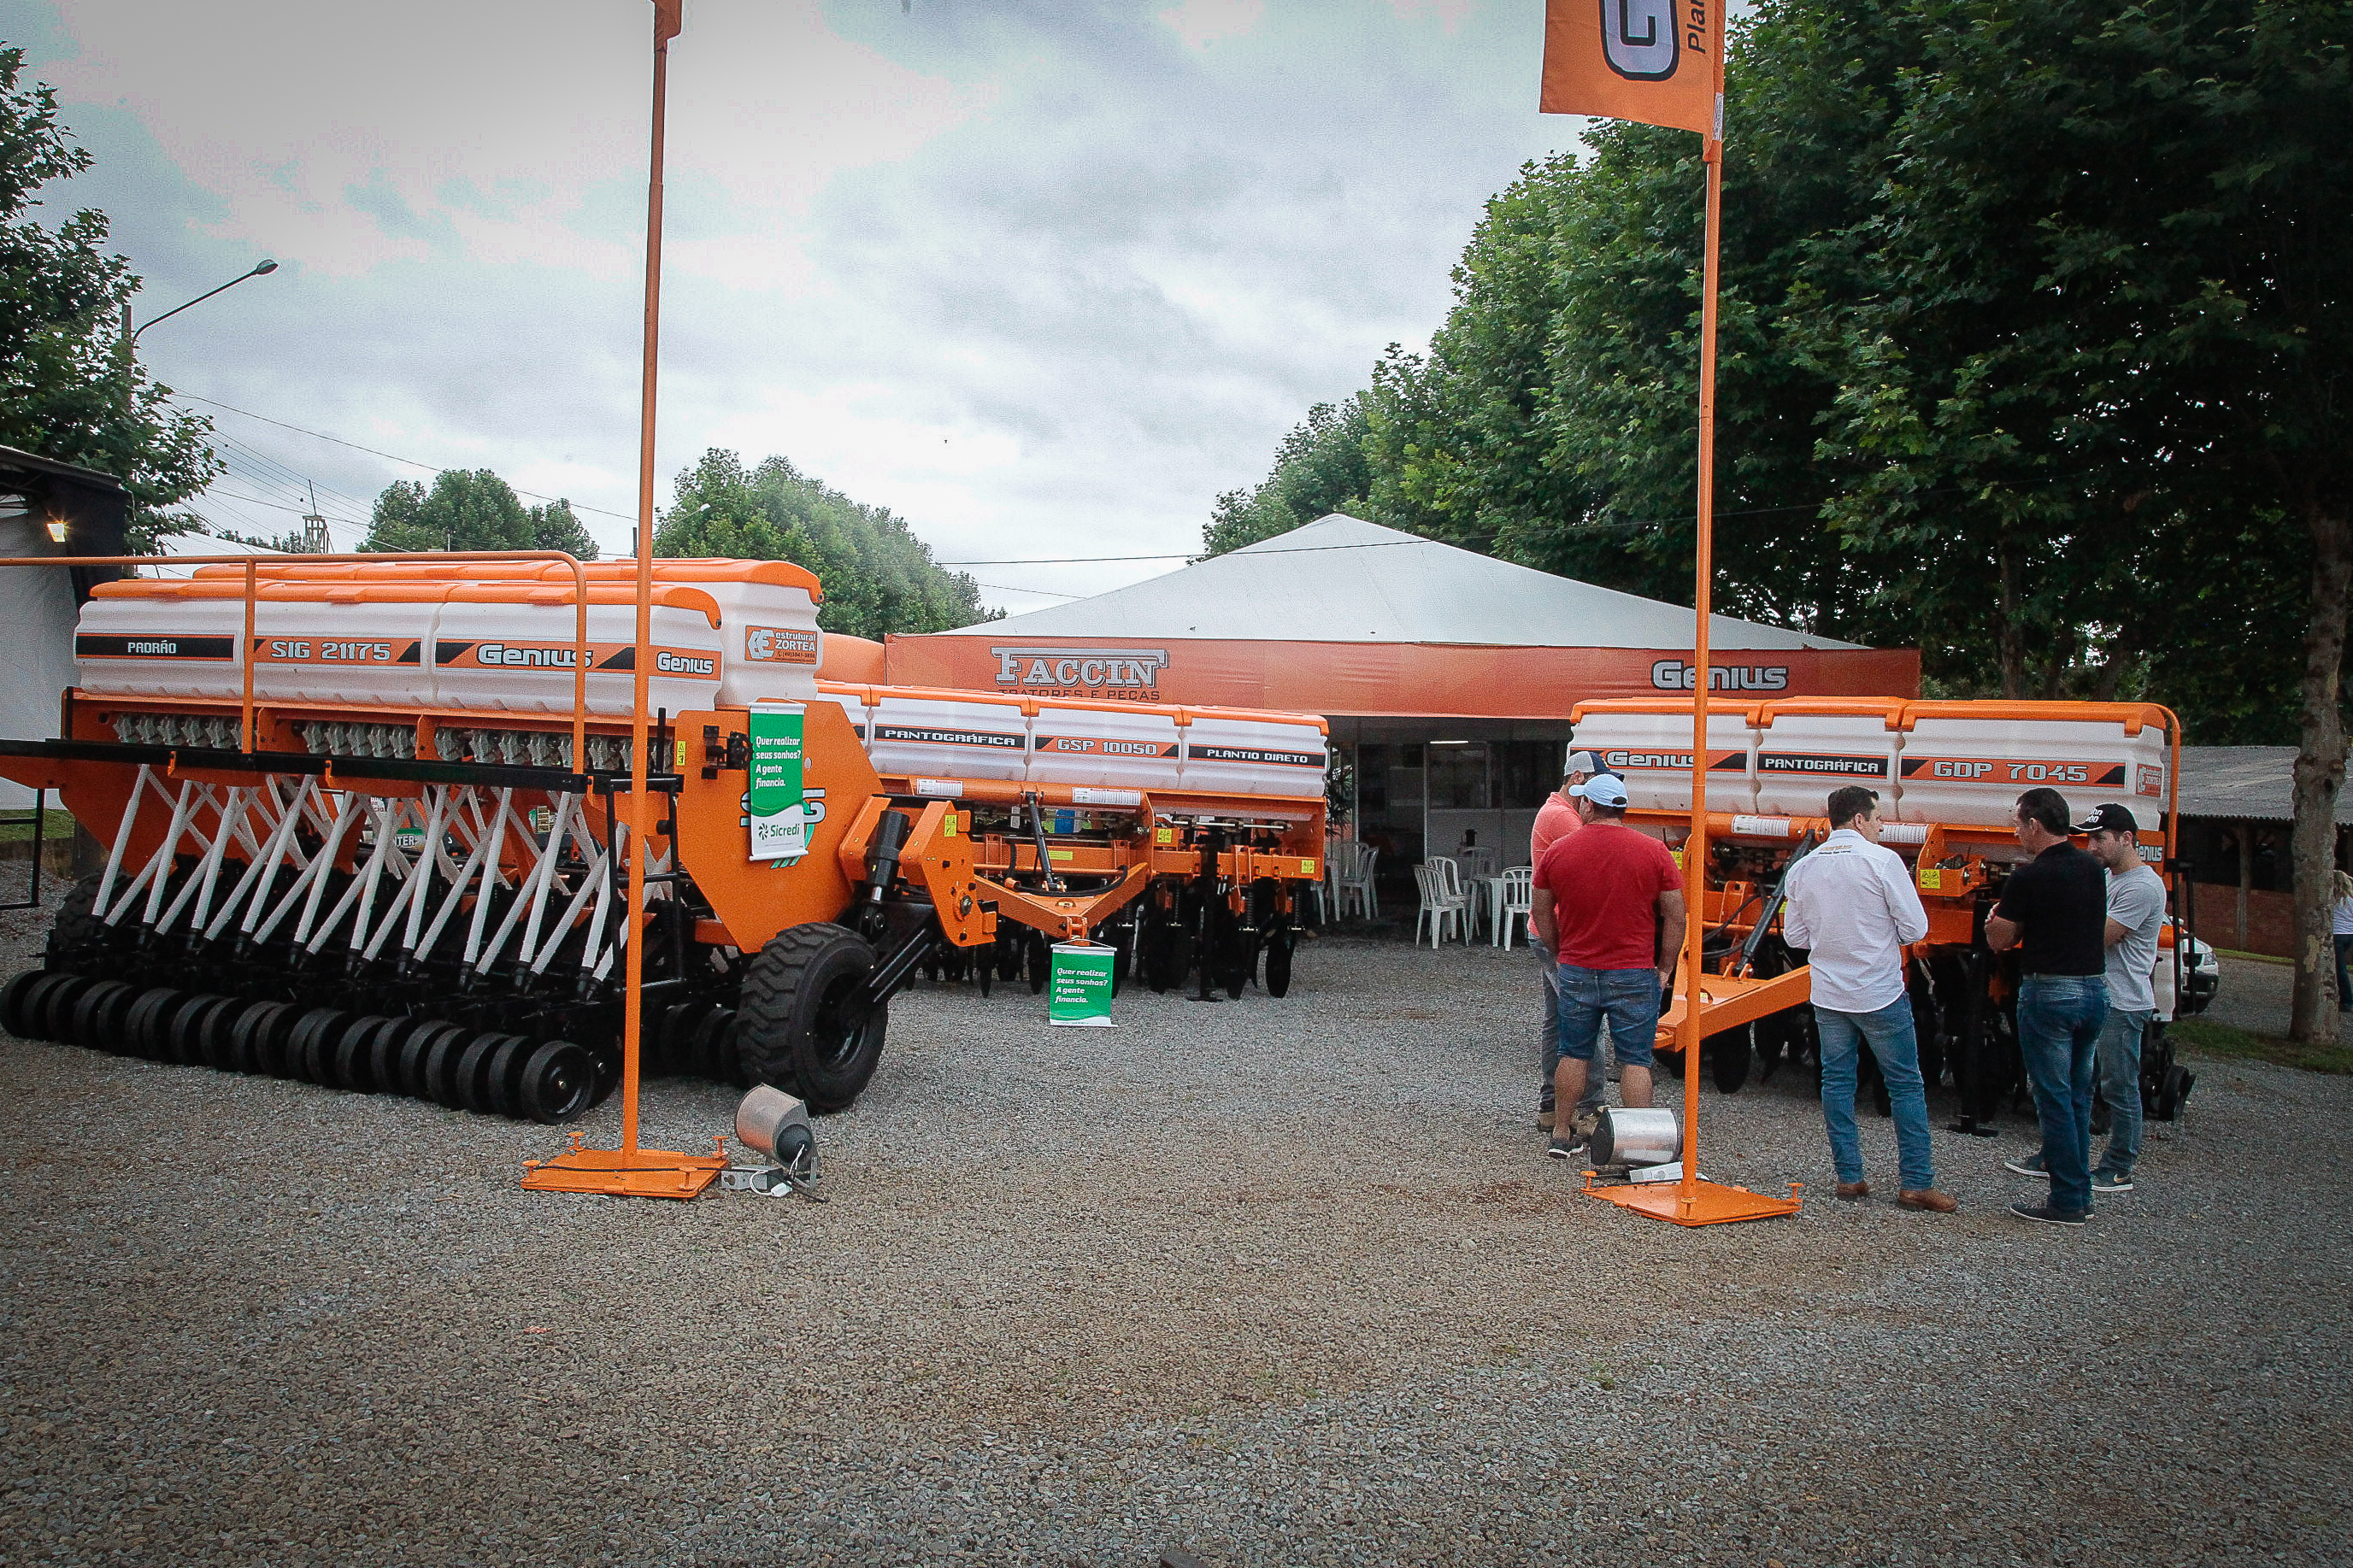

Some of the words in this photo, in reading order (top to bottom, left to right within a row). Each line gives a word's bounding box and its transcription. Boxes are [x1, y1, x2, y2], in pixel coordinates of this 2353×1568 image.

[775, 631, 815, 642] estrutural
[127, 640, 177, 655] PADRÃO
[271, 641, 310, 660] SIG
[321, 641, 391, 661] 21175
[477, 643, 593, 667] Genius
[656, 652, 714, 675] Genius
[990, 647, 1168, 688] FACCIN
[1091, 690, 1100, 699] E
[756, 736, 774, 748] Quer
[774, 736, 801, 746] realizar
[885, 730, 1015, 746] PANTOGRÁFICA
[756, 751, 773, 760] seus
[773, 749, 802, 760] sonhos?
[1056, 738, 1095, 753] GSP
[1103, 742, 1158, 756] 10050
[1206, 749, 1260, 761] PLANTIO
[1263, 751, 1309, 764] DIRETO
[1606, 750, 1694, 767] Geniu
[756, 764, 762, 773] A
[762, 765, 783, 776] gente
[1765, 757, 1879, 772] PANTOGRÁFICA
[1933, 761, 1993, 778] GDP
[2007, 762, 2088, 782] 7045
[756, 778, 786, 790] financia.
[770, 823, 800, 837] Sicredi
[1056, 967, 1076, 977] Quer
[1077, 969, 1108, 978] realizar
